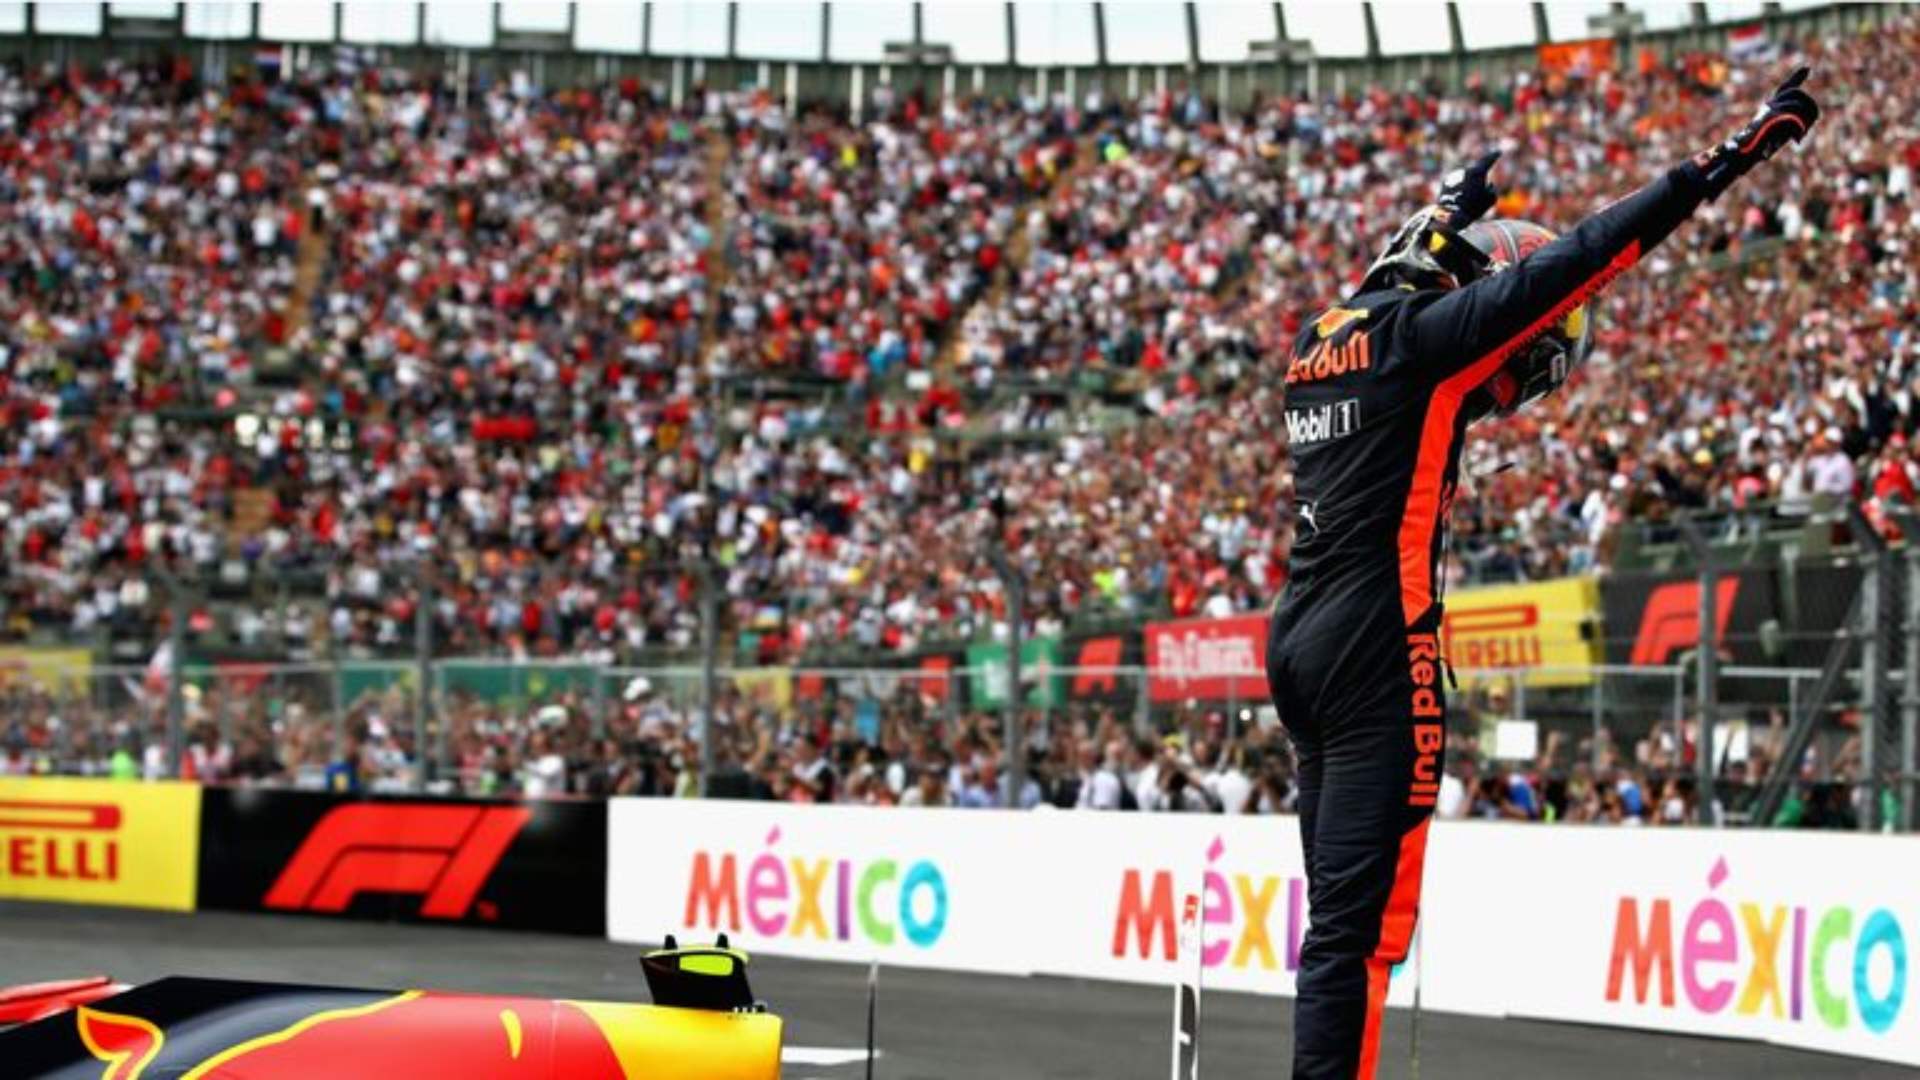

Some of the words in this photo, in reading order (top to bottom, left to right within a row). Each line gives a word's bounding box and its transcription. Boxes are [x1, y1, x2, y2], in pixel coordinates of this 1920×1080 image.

[1406, 634, 1442, 716] Red
[1408, 724, 1442, 806] Bull
[4, 837, 119, 884] ELLI
